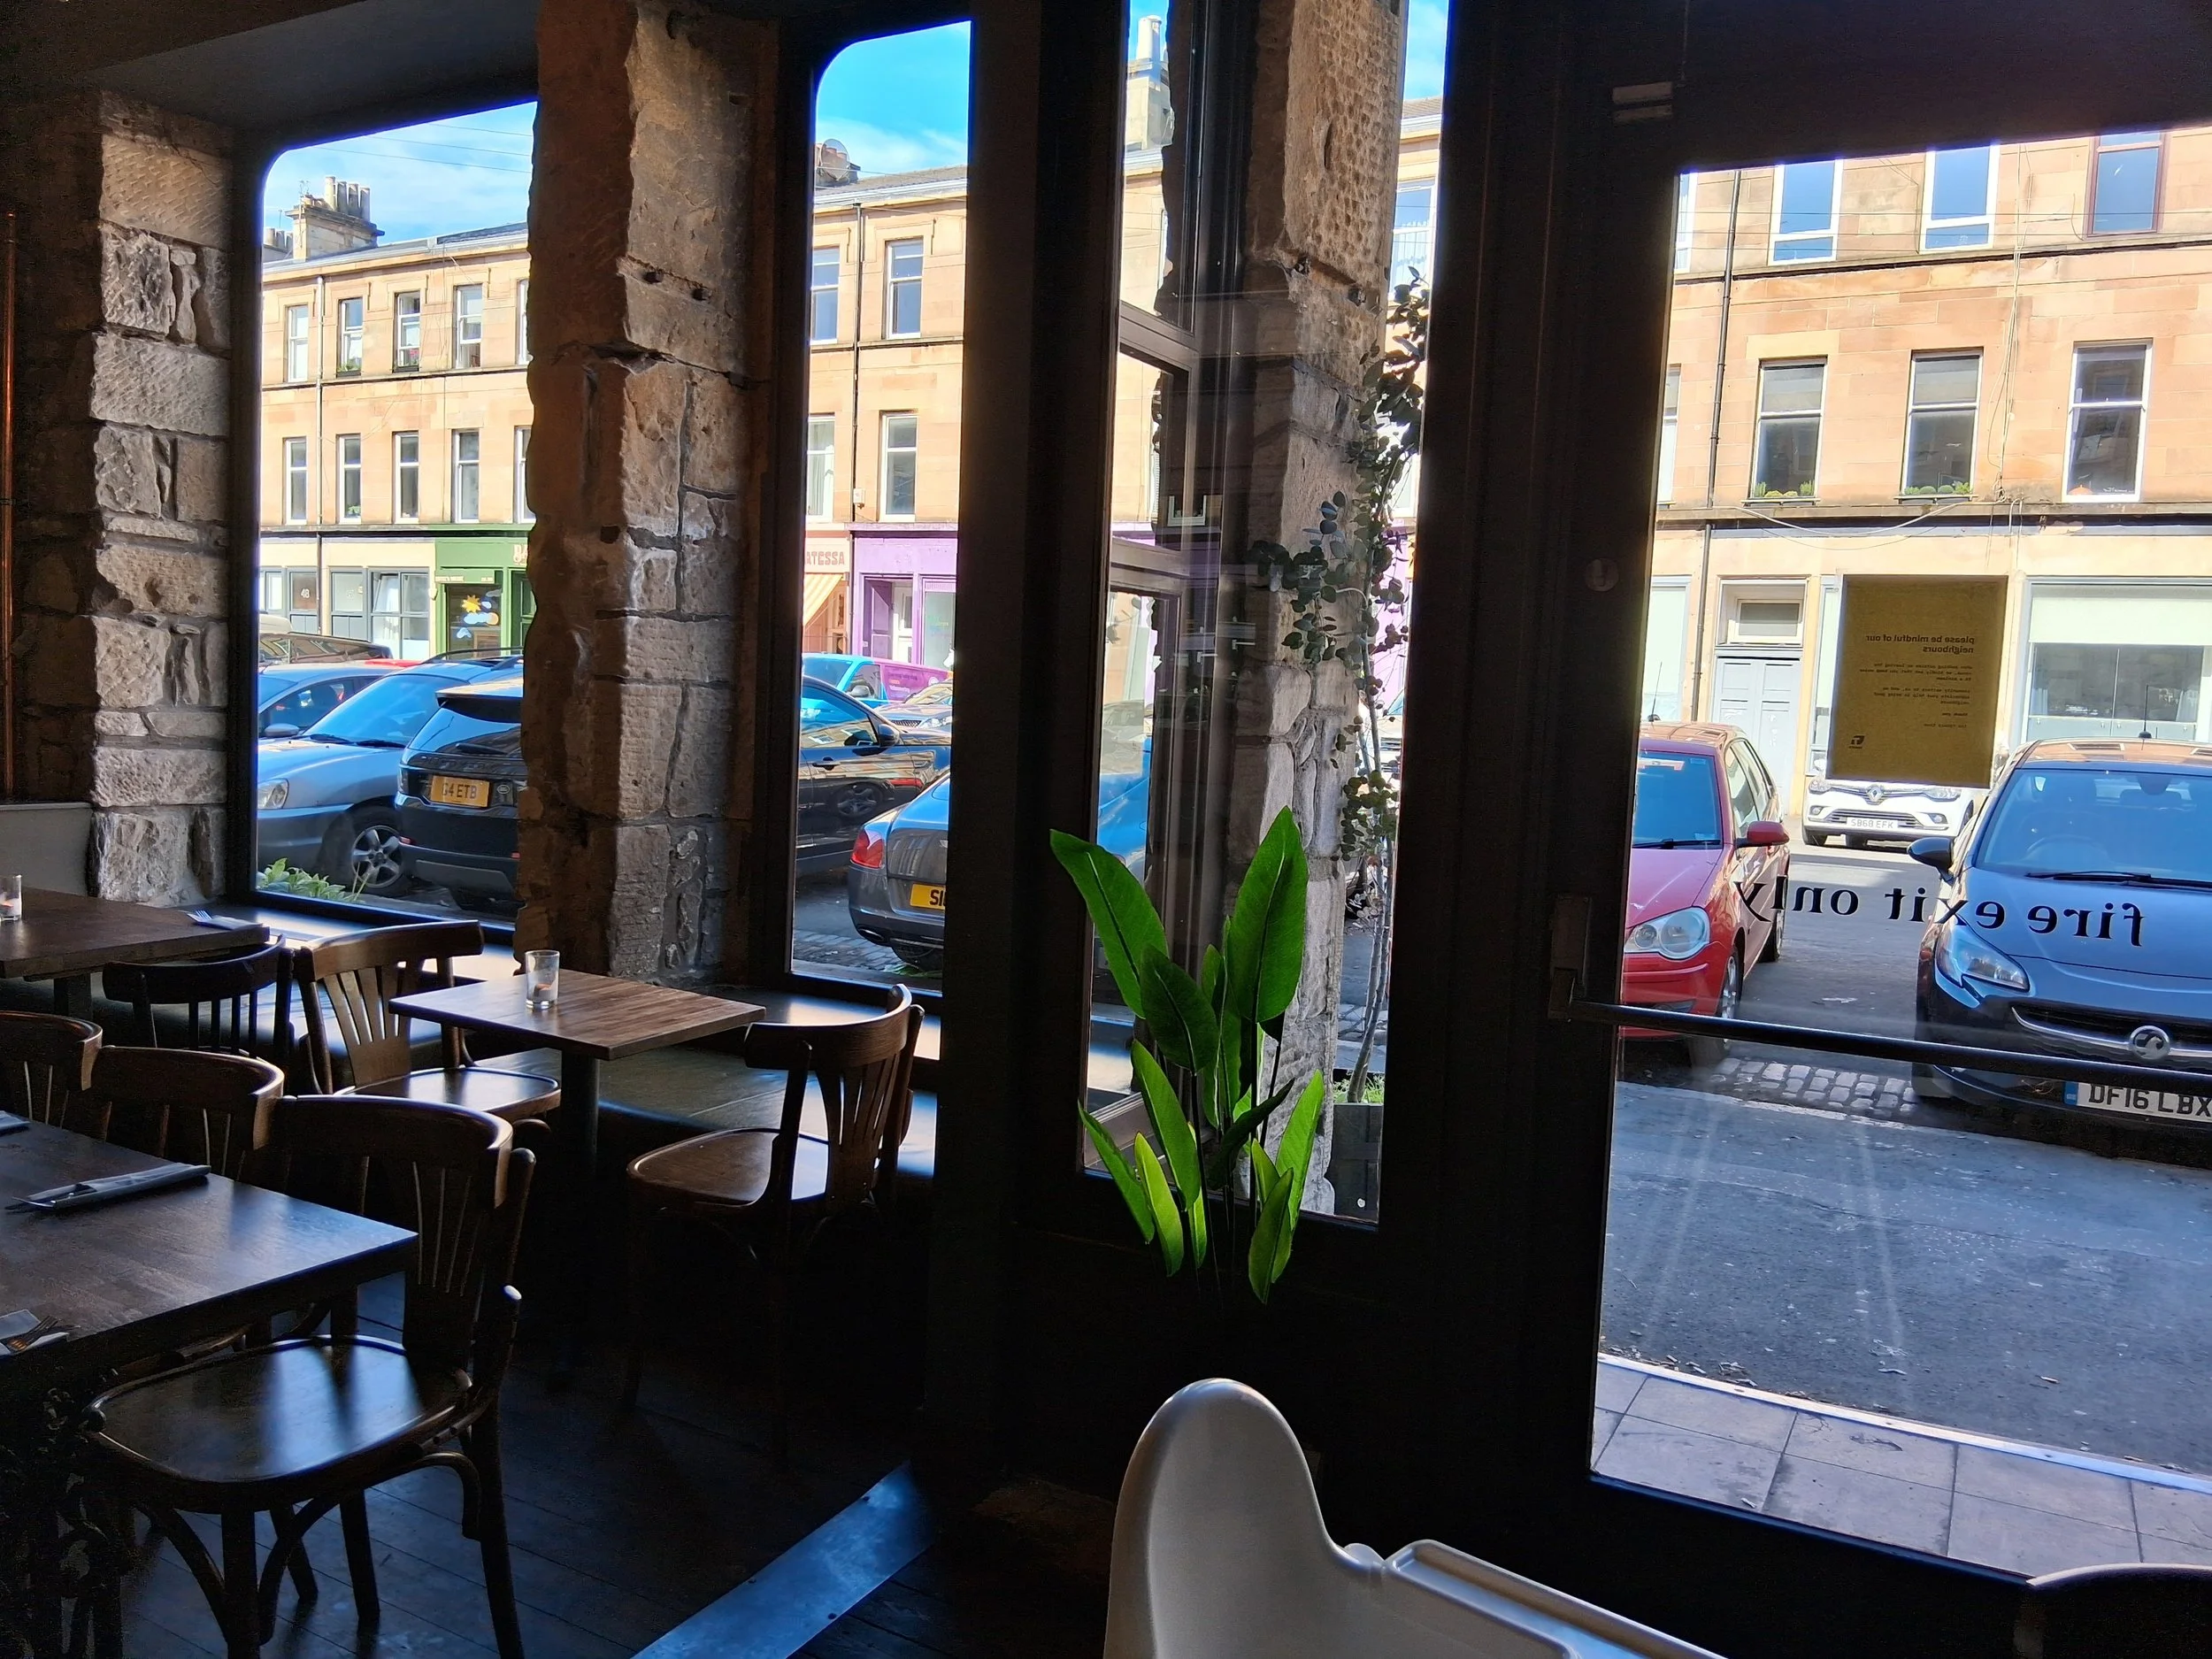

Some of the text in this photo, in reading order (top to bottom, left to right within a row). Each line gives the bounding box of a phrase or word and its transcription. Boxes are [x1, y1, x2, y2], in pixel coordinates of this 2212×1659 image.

[457, 784, 477, 799] ETB
[2088, 1083, 2211, 1118] DF16 LBX
